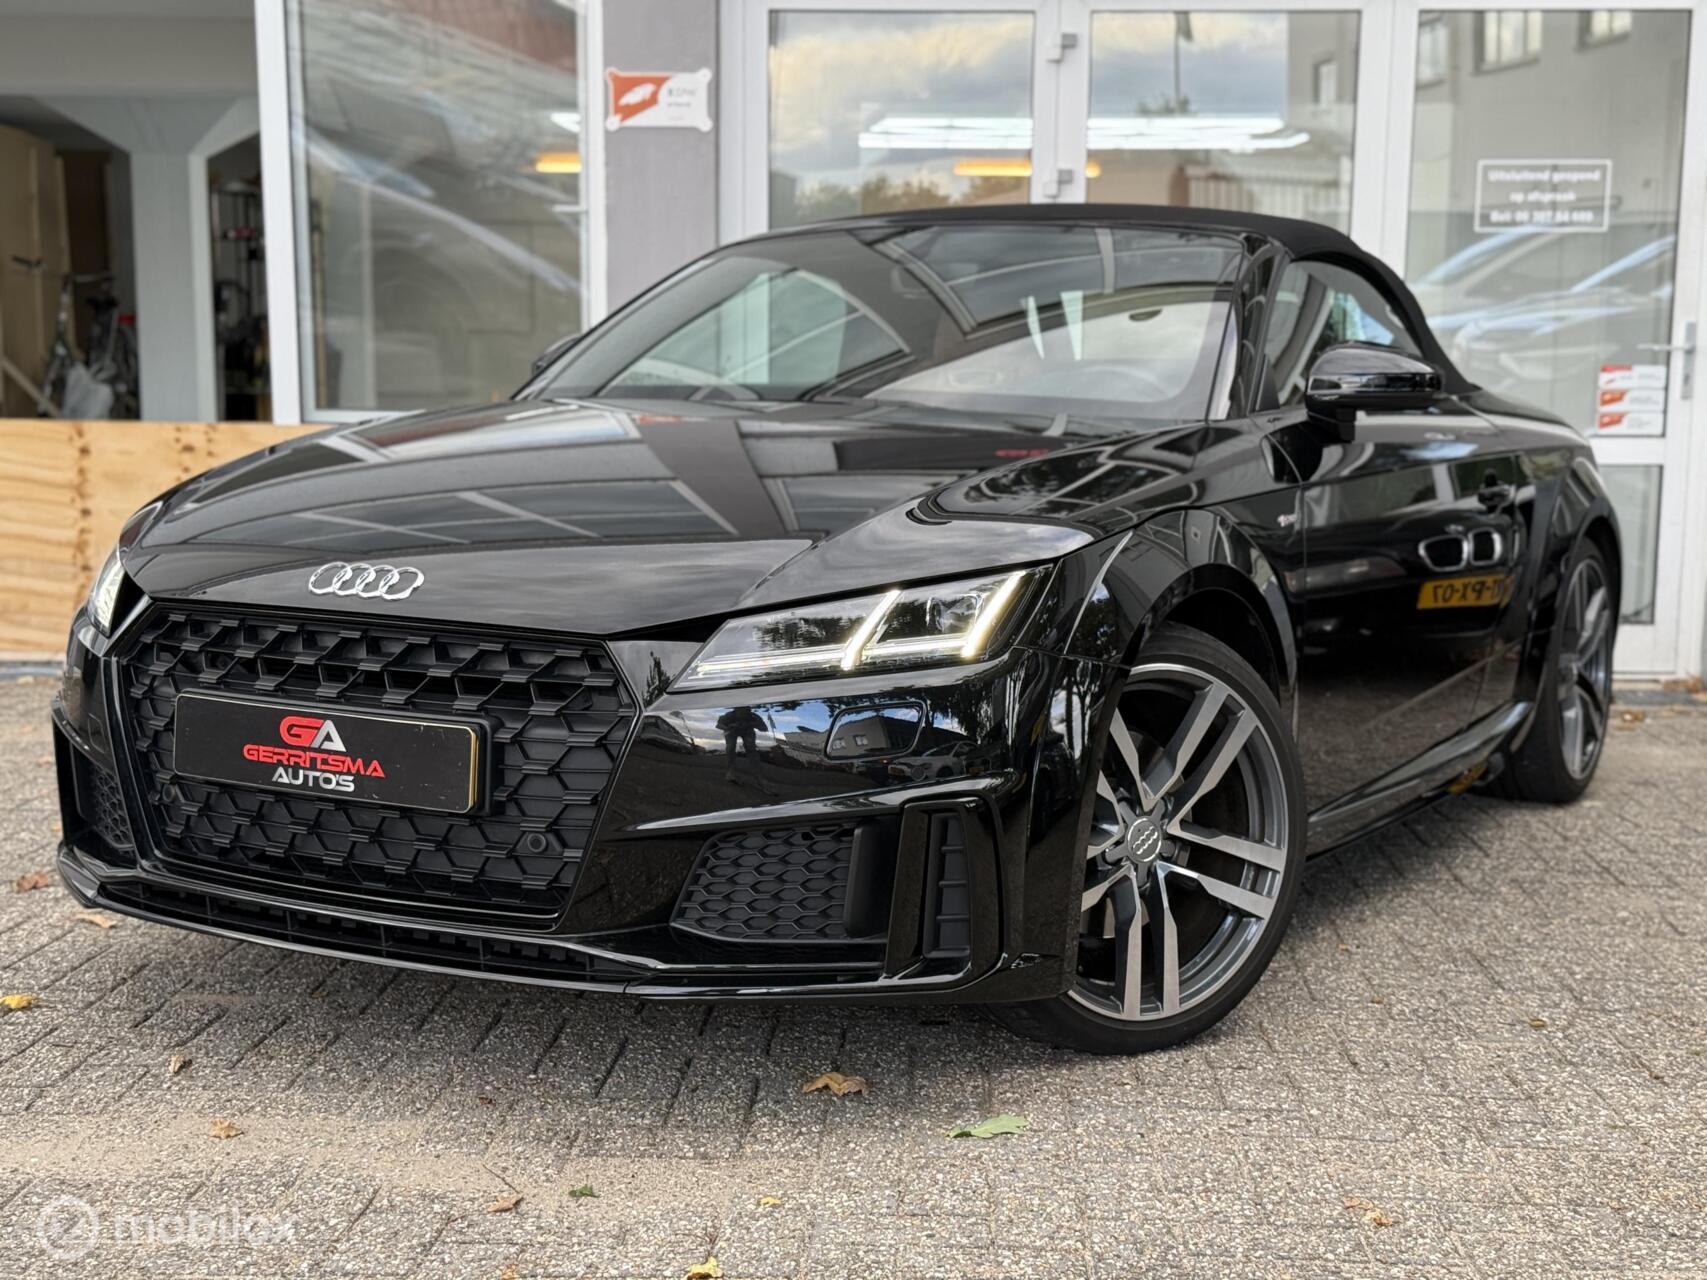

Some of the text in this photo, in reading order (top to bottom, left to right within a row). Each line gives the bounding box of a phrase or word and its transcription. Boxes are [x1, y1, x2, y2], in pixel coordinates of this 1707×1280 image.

[279, 715, 346, 752] GA
[243, 744, 385, 778] GERRITSMA
[271, 766, 355, 792] AUTO'S
